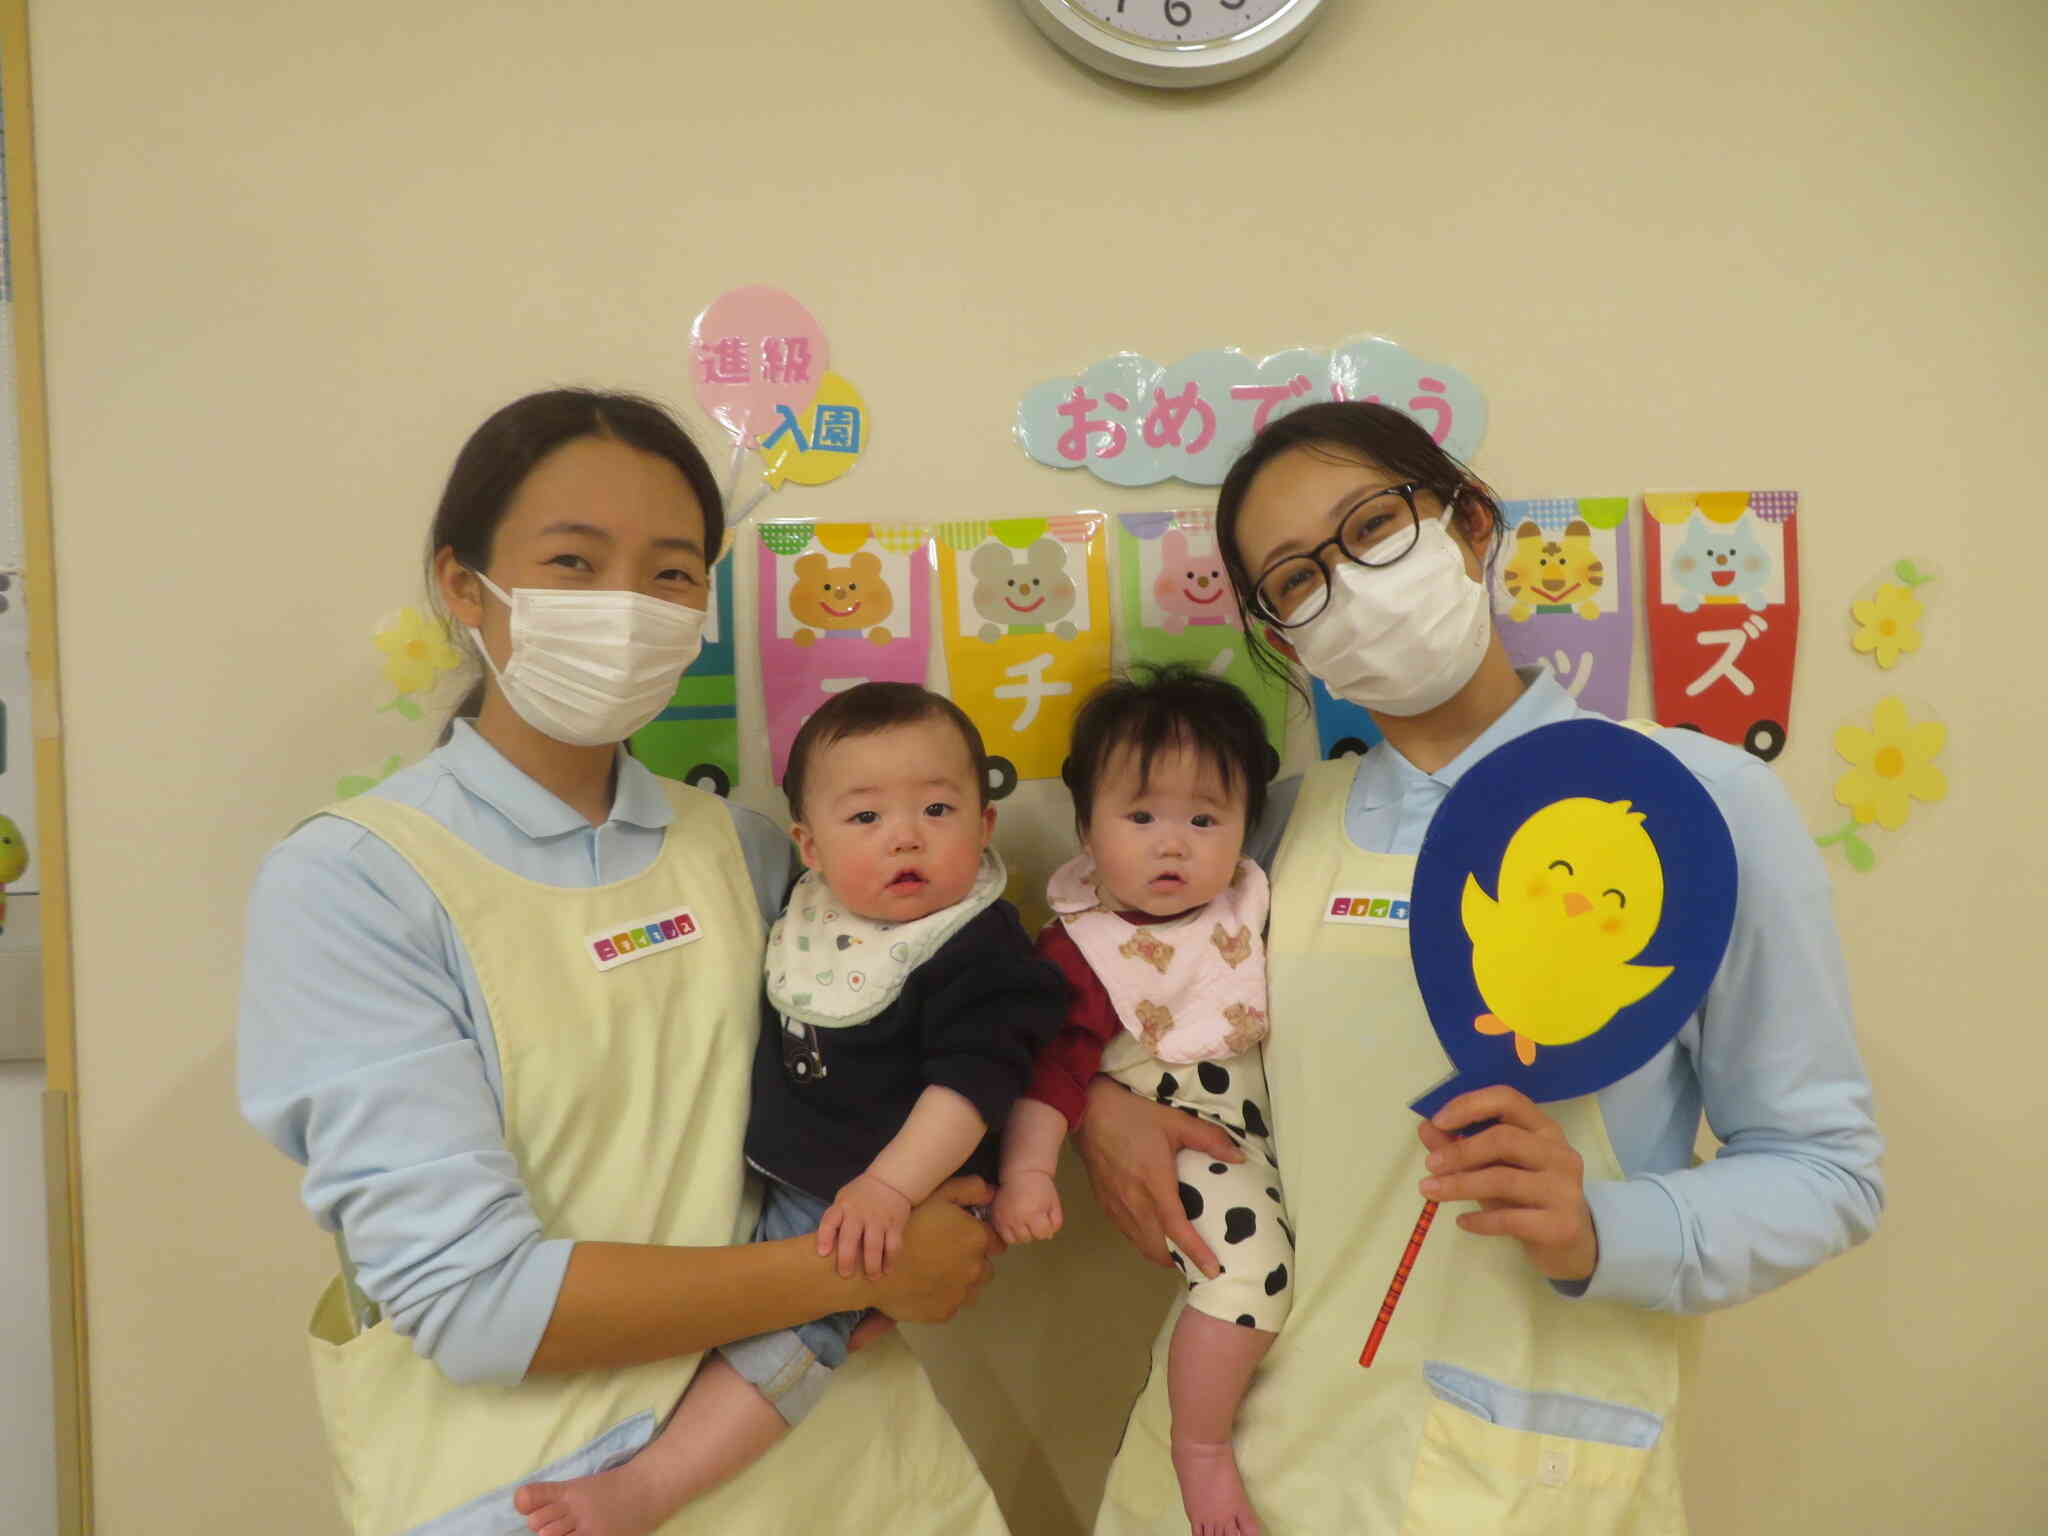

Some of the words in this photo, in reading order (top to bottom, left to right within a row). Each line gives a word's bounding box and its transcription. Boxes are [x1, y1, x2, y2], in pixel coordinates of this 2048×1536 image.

[697, 336, 812, 384] 進級
[761, 404, 860, 454] 入園
[1056, 374, 1453, 461] おめでう
